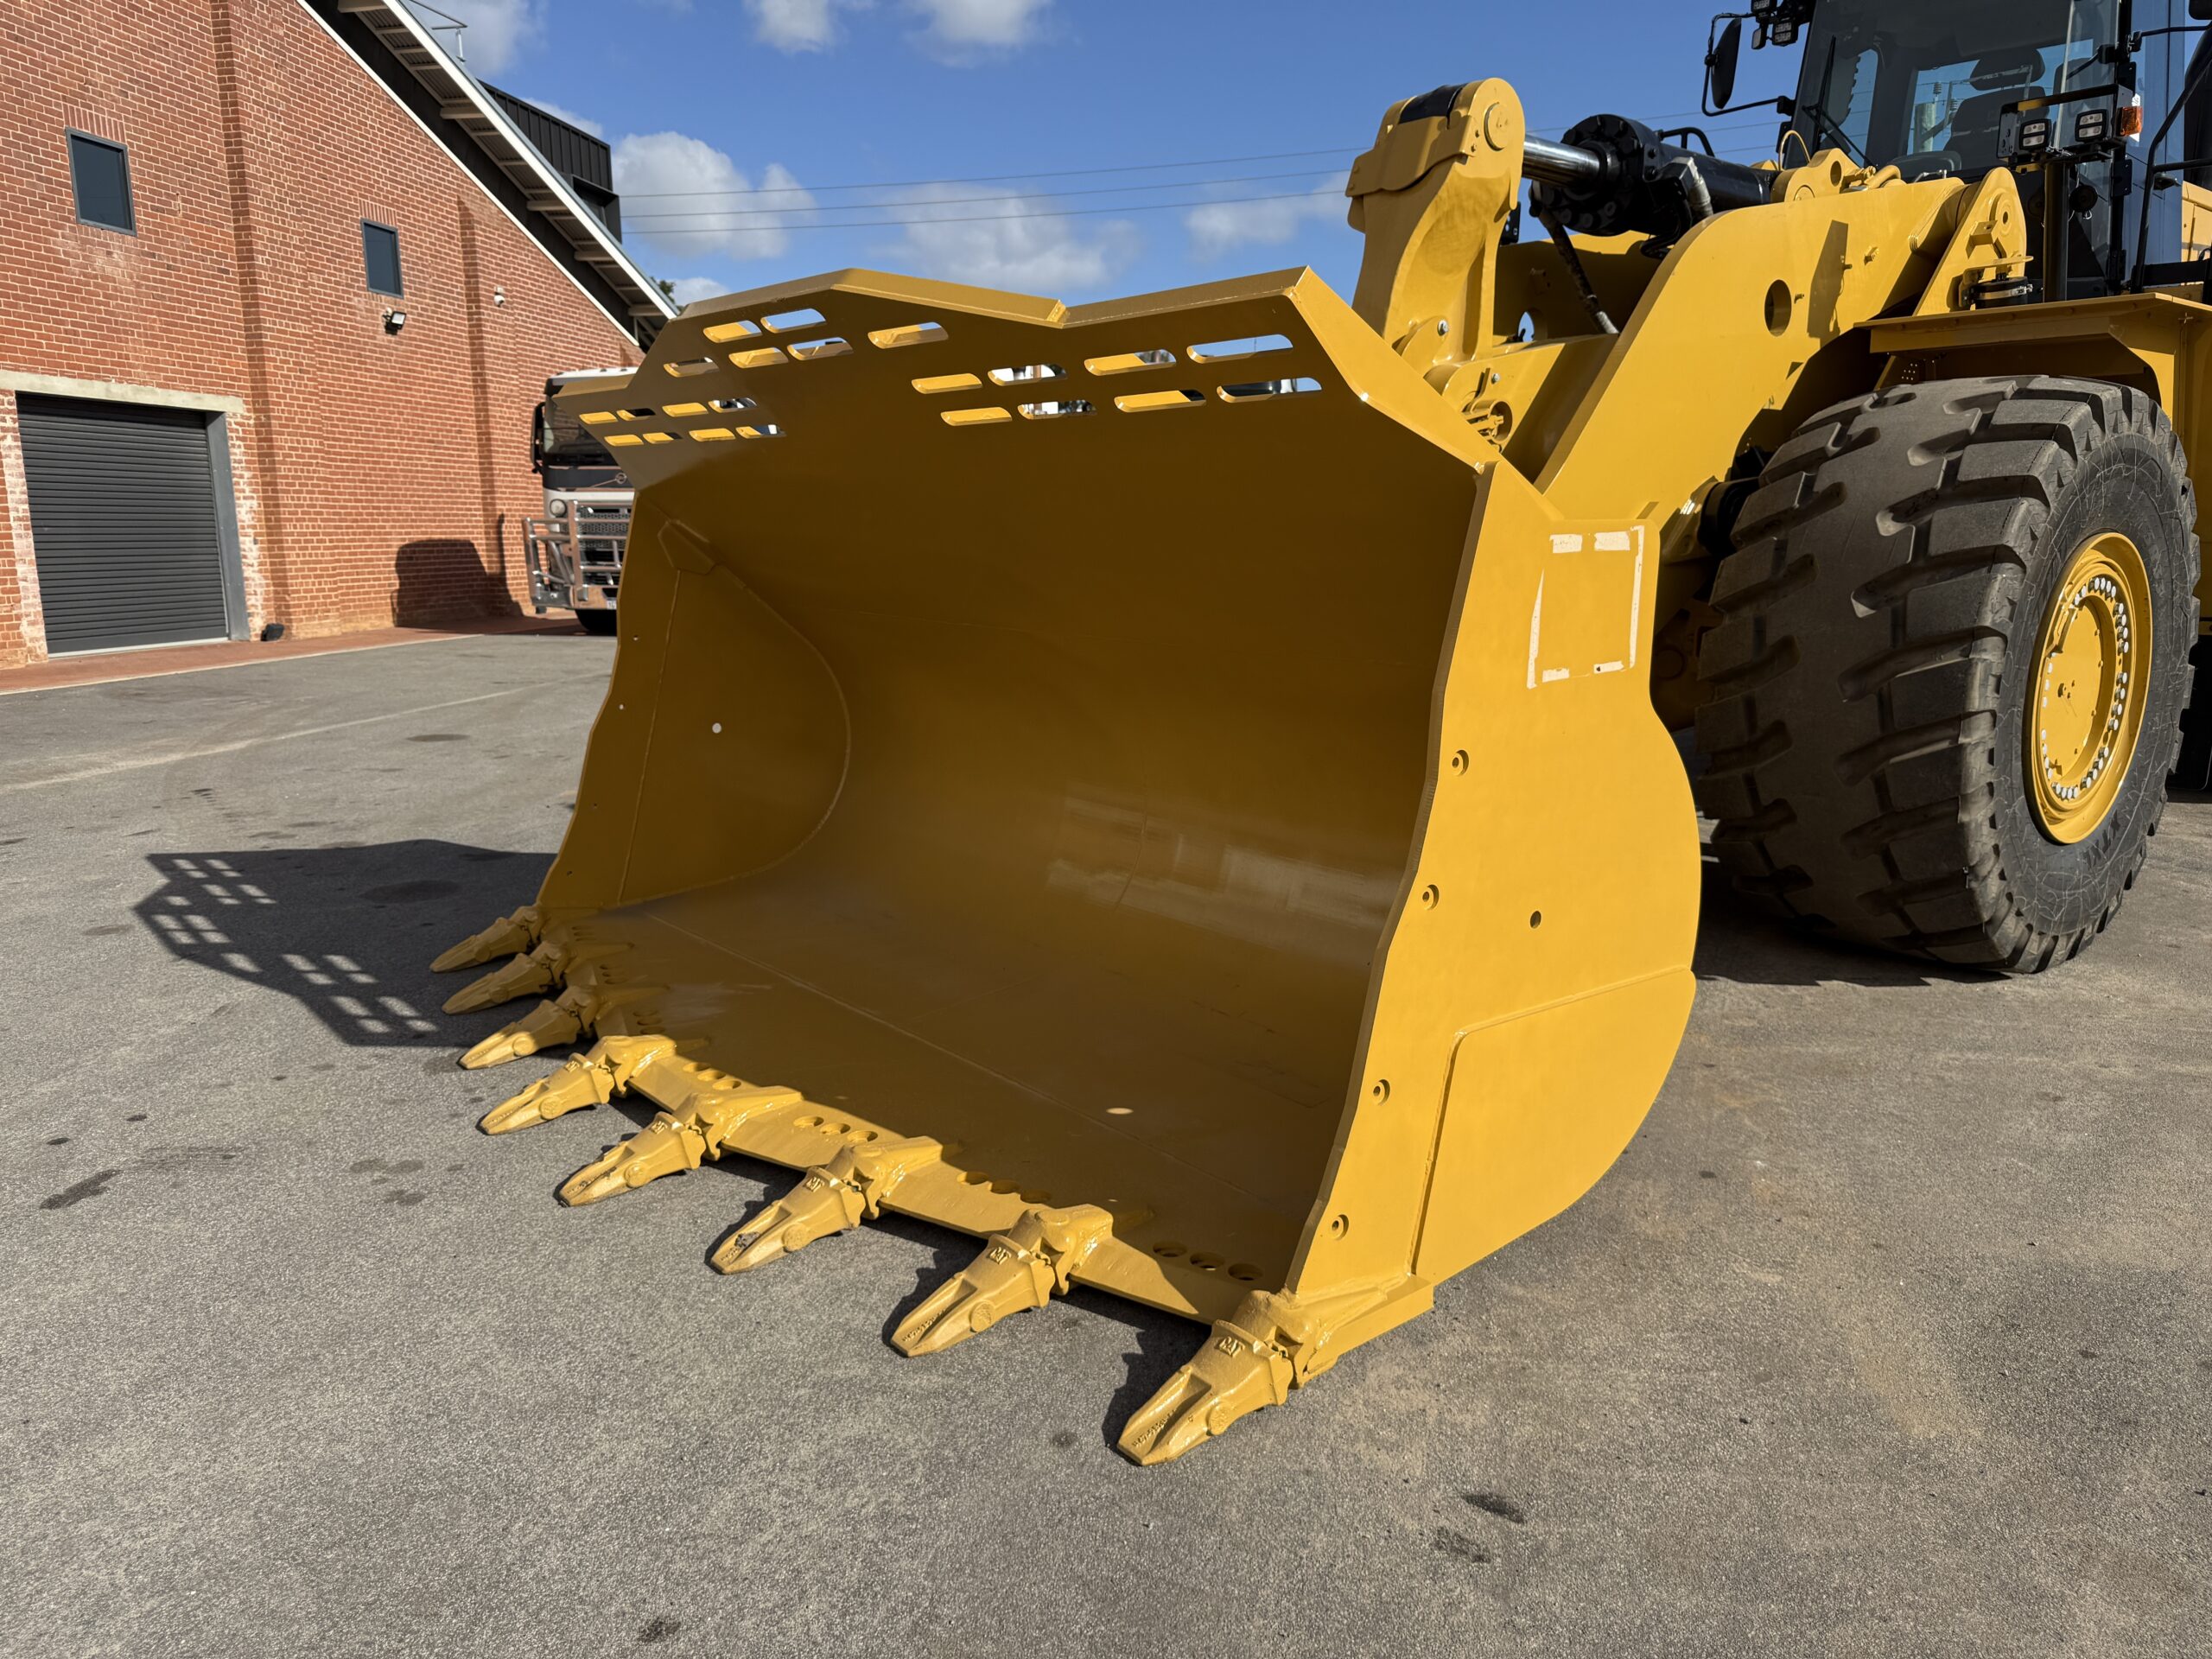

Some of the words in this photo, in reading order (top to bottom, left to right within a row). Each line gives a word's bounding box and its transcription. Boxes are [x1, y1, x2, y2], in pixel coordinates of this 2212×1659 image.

[805, 1176, 825, 1192] CAT
[989, 1246, 1012, 1265] CAT
[1217, 1336, 1246, 1357] CAT
